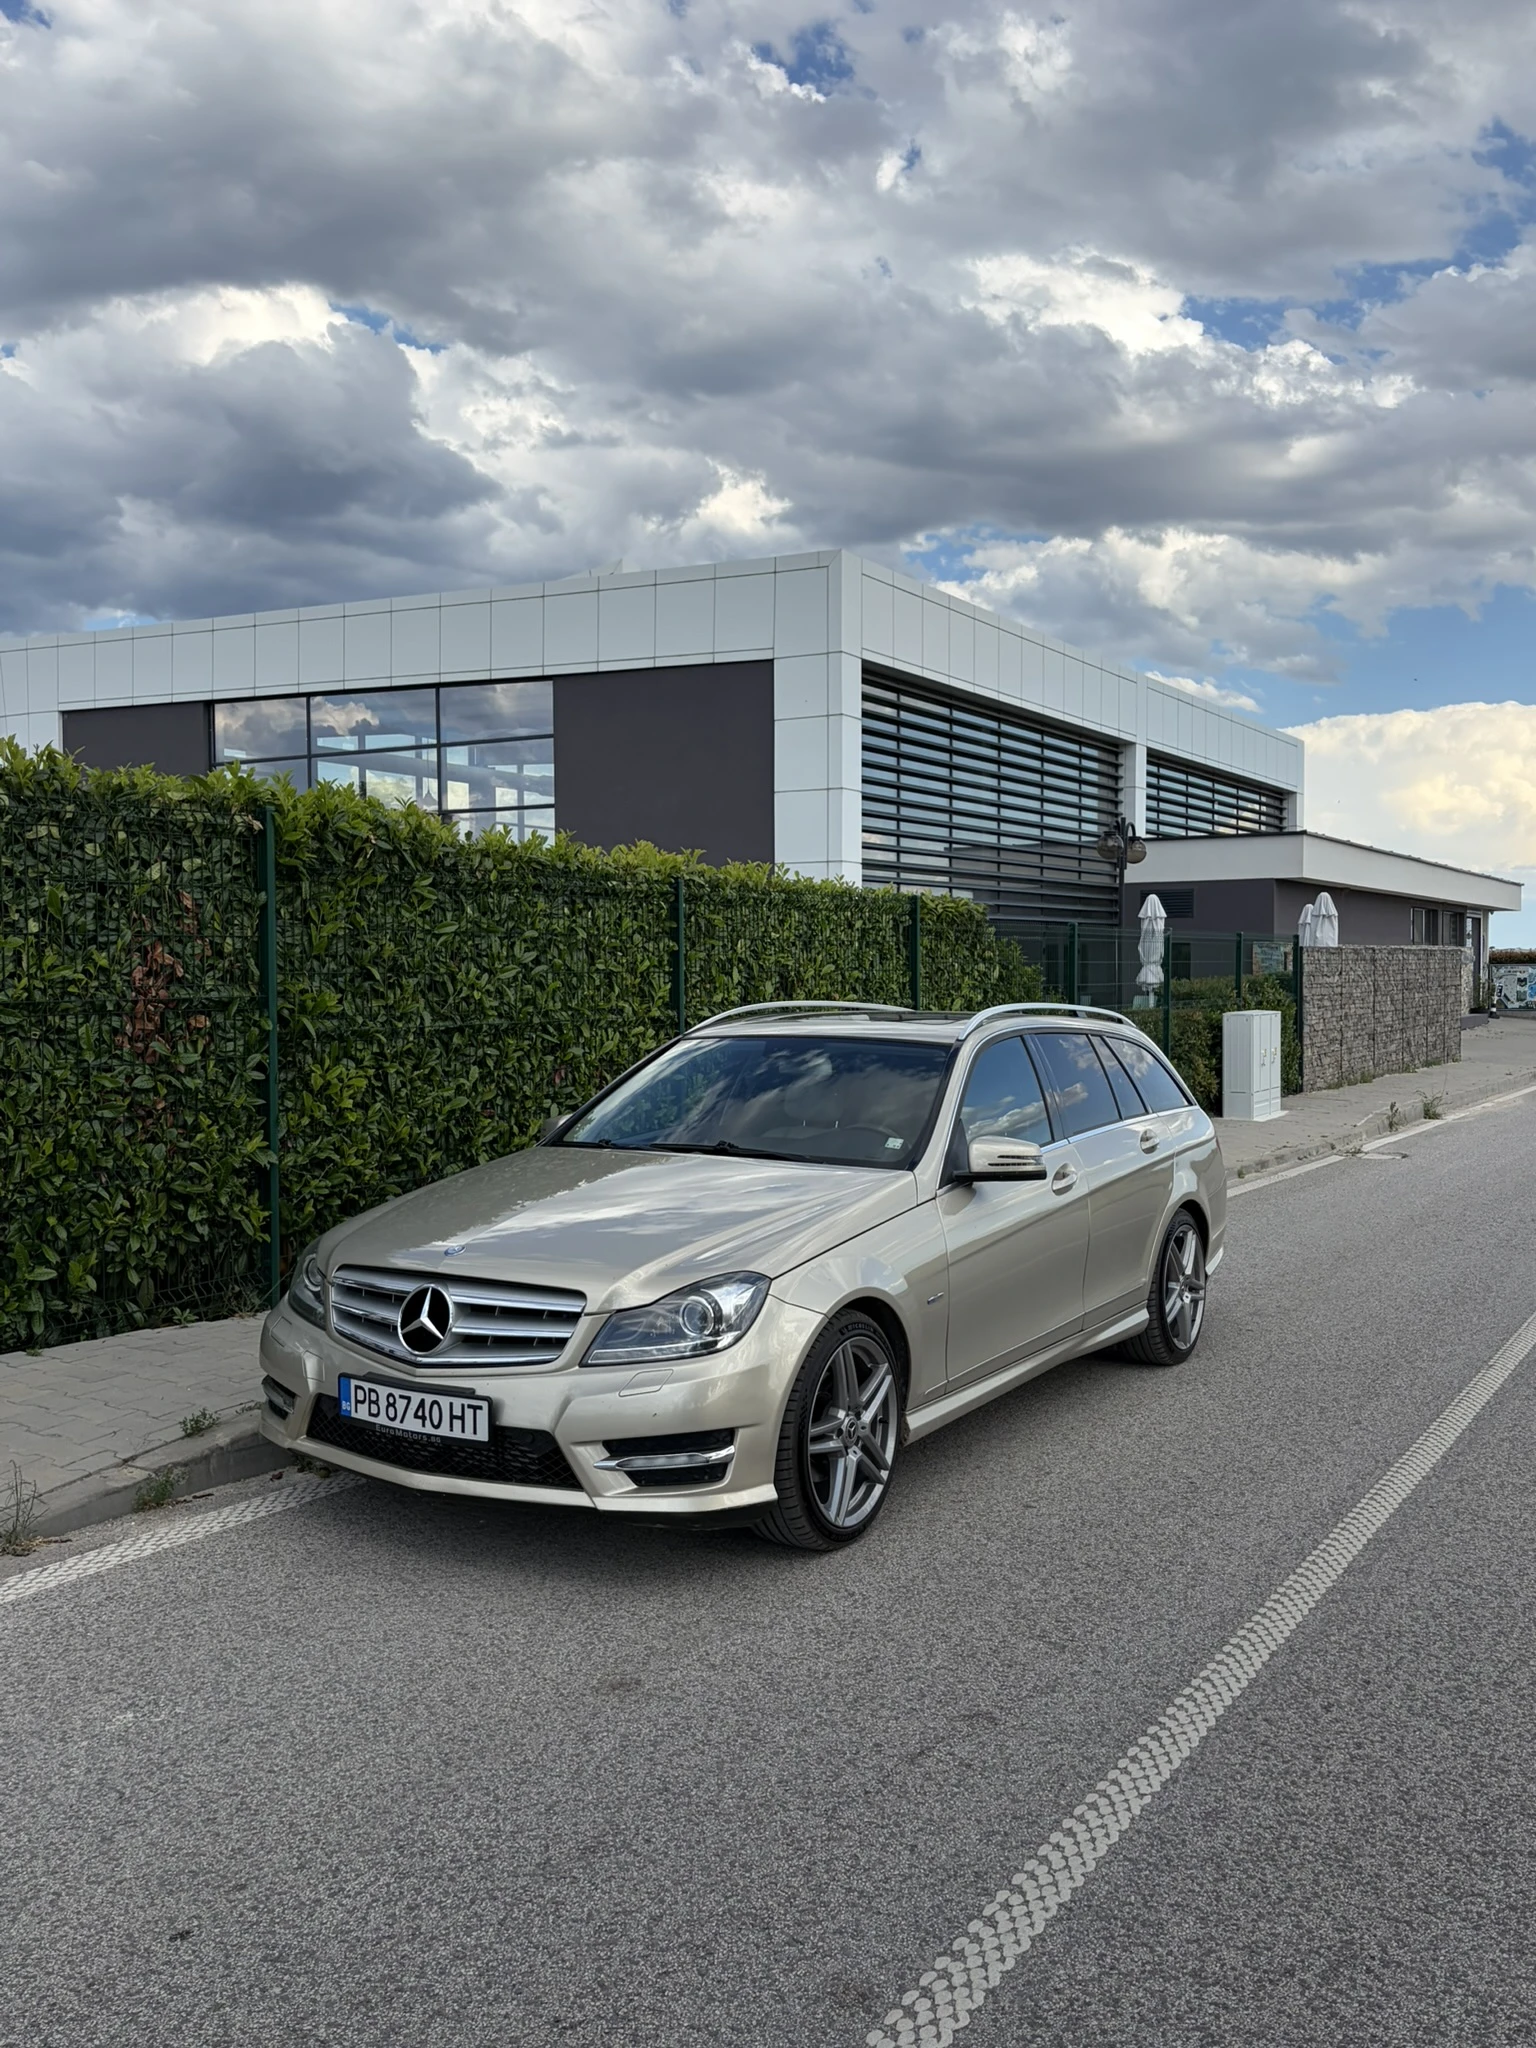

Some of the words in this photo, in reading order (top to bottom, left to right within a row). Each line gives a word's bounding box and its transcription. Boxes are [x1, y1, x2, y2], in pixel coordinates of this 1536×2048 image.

[341, 1400, 351, 1411] BG
[354, 1384, 381, 1418] PB
[385, 1392, 443, 1430] 8740
[449, 1401, 483, 1435] HT
